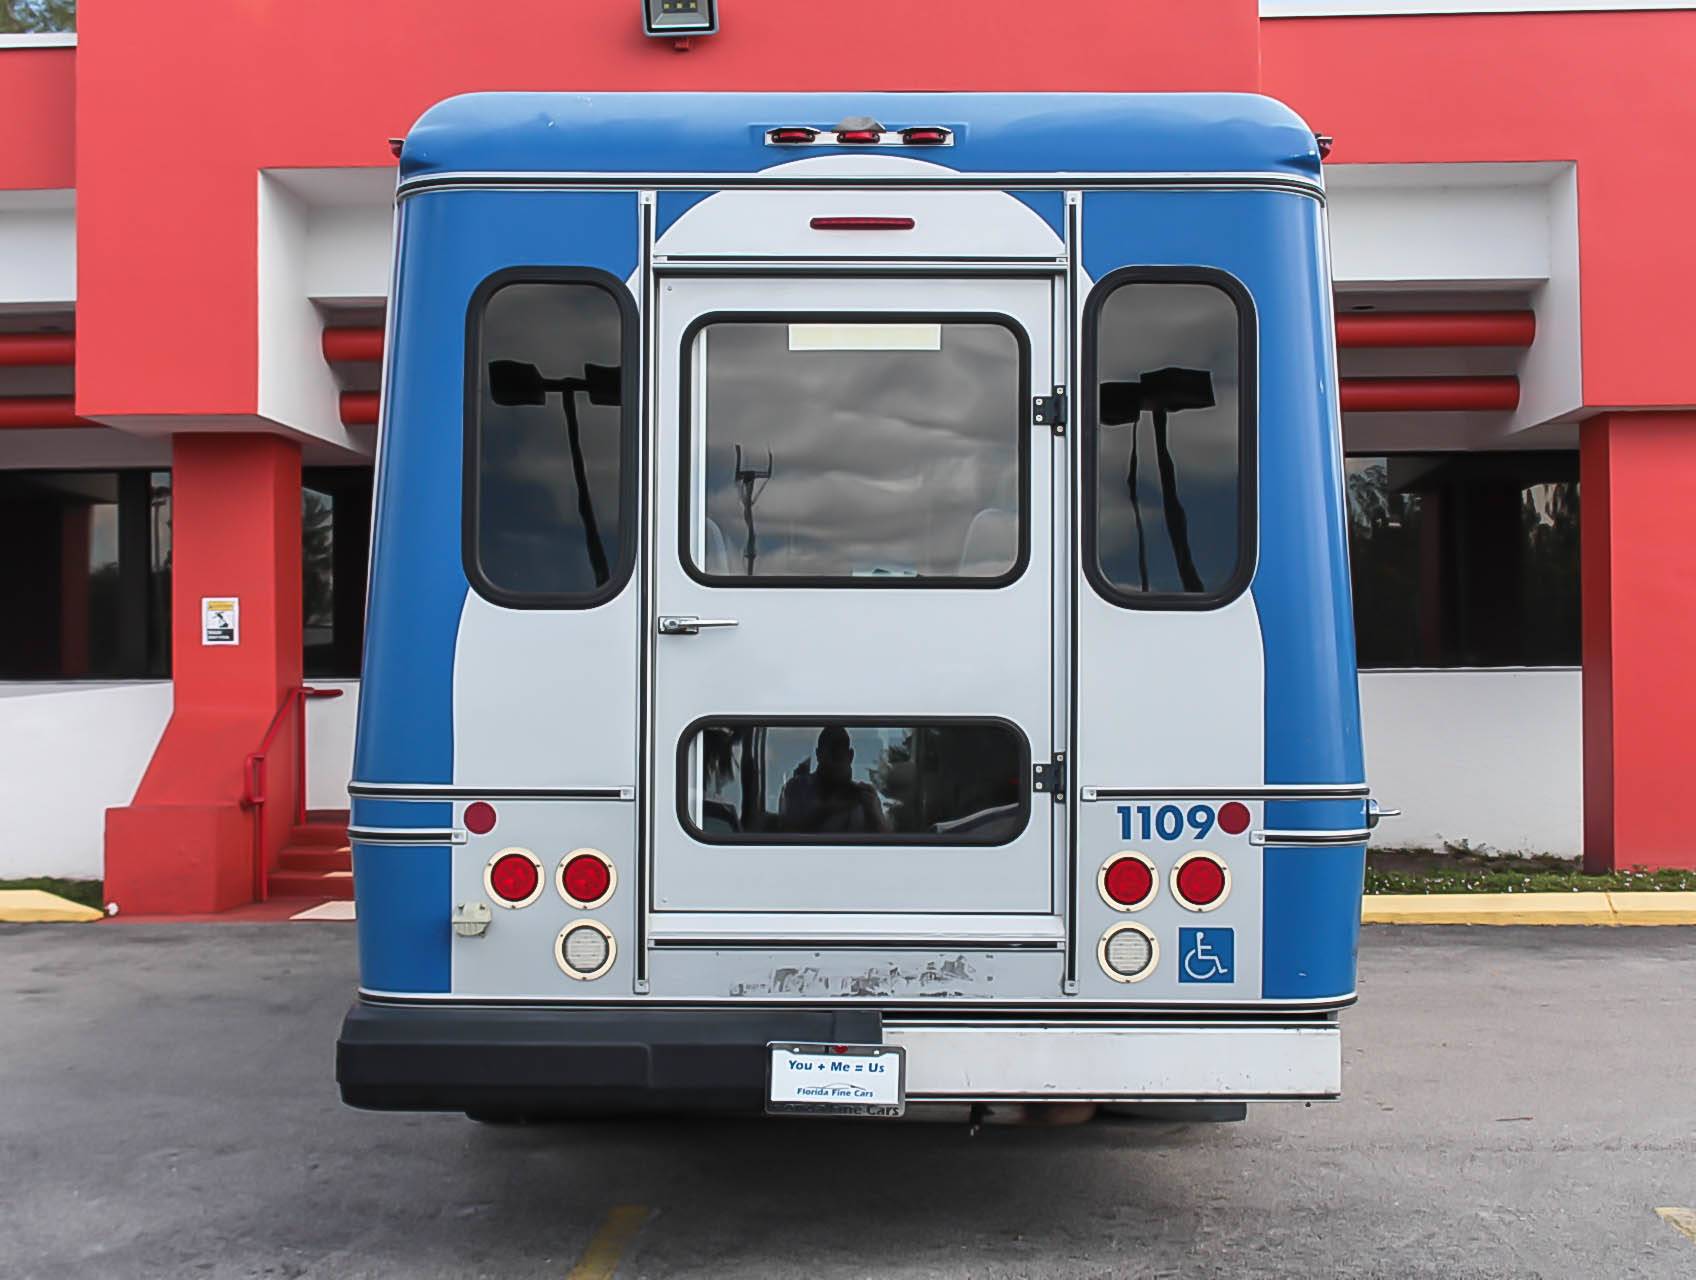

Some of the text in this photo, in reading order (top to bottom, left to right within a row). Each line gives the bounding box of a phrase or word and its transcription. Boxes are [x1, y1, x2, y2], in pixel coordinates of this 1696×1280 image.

[1117, 804, 1216, 841] 1109
[788, 1060, 885, 1073] You + Me = Us
[796, 1087, 874, 1098] Florida Fine Cars
[866, 1104, 900, 1117] Cars
